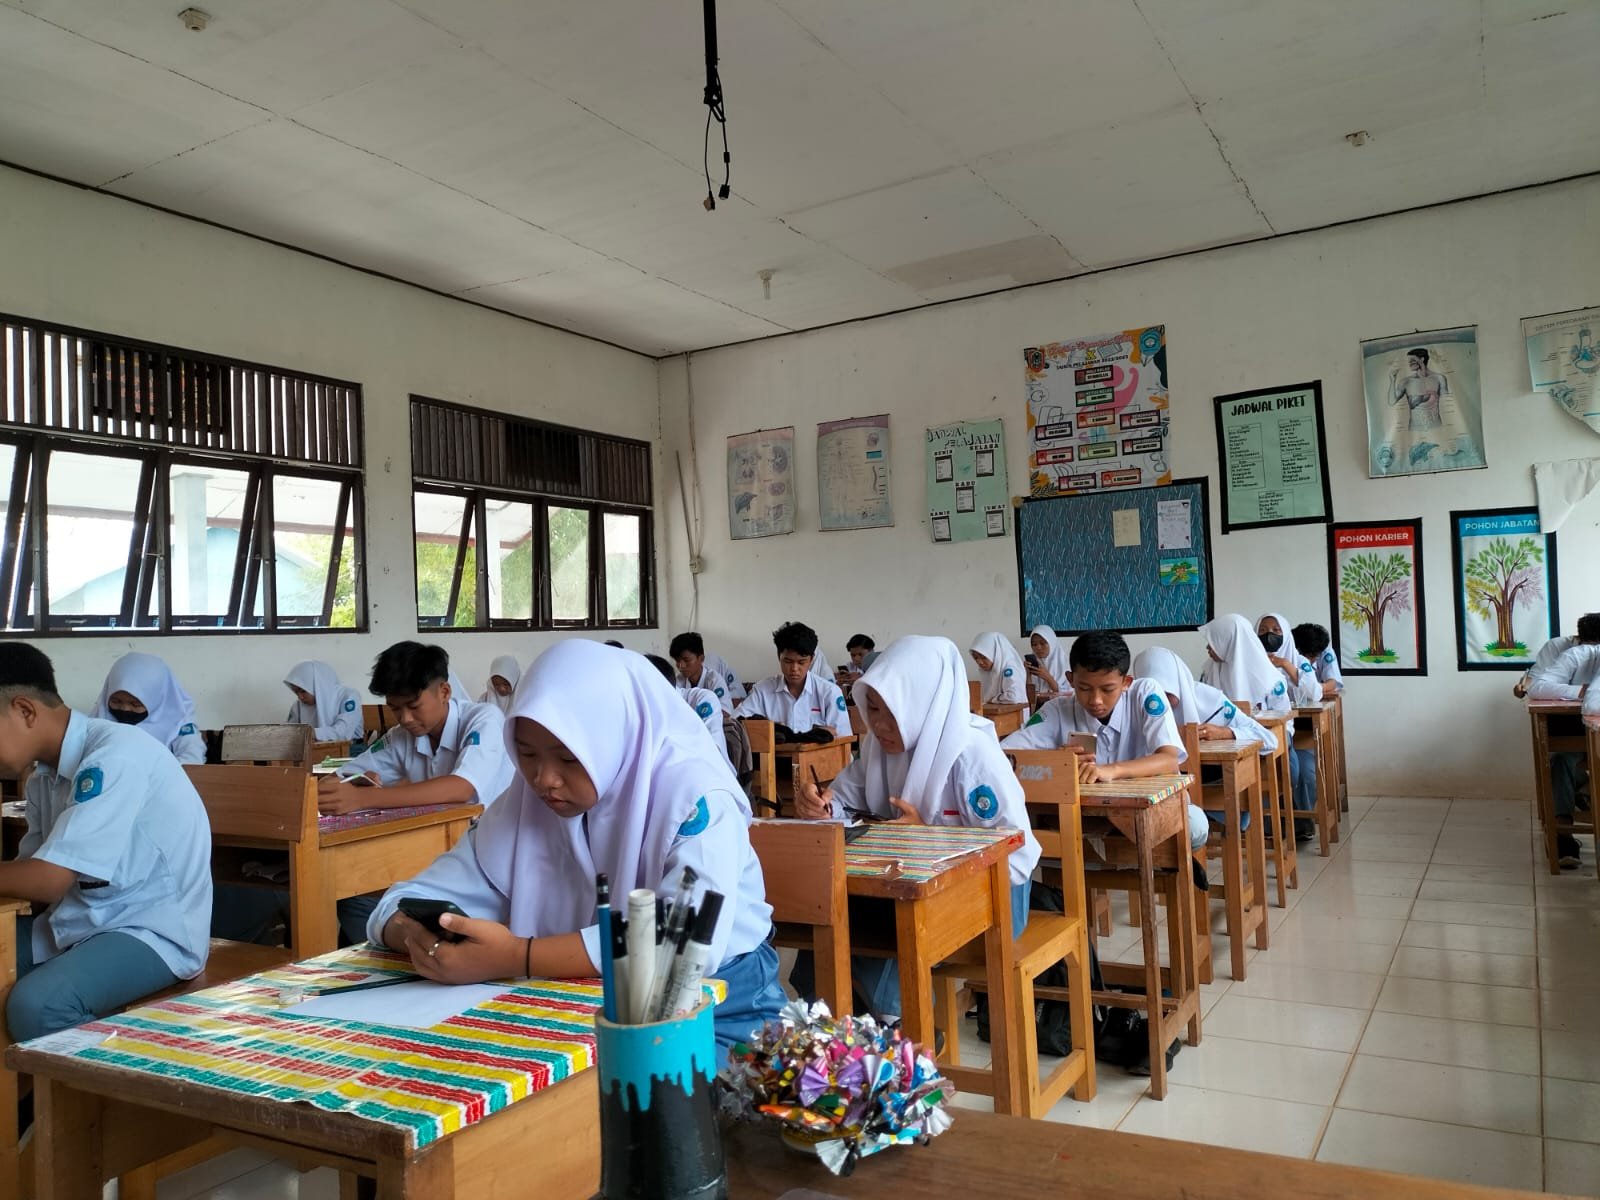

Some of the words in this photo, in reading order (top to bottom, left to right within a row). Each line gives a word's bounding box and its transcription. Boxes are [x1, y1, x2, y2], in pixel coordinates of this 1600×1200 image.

[1231, 400, 1275, 417] JADWAL
[1276, 394, 1306, 410] PIKET
[1465, 521, 1498, 530] POHON
[1339, 534, 1373, 544] POHON
[1375, 532, 1409, 542] KARIER
